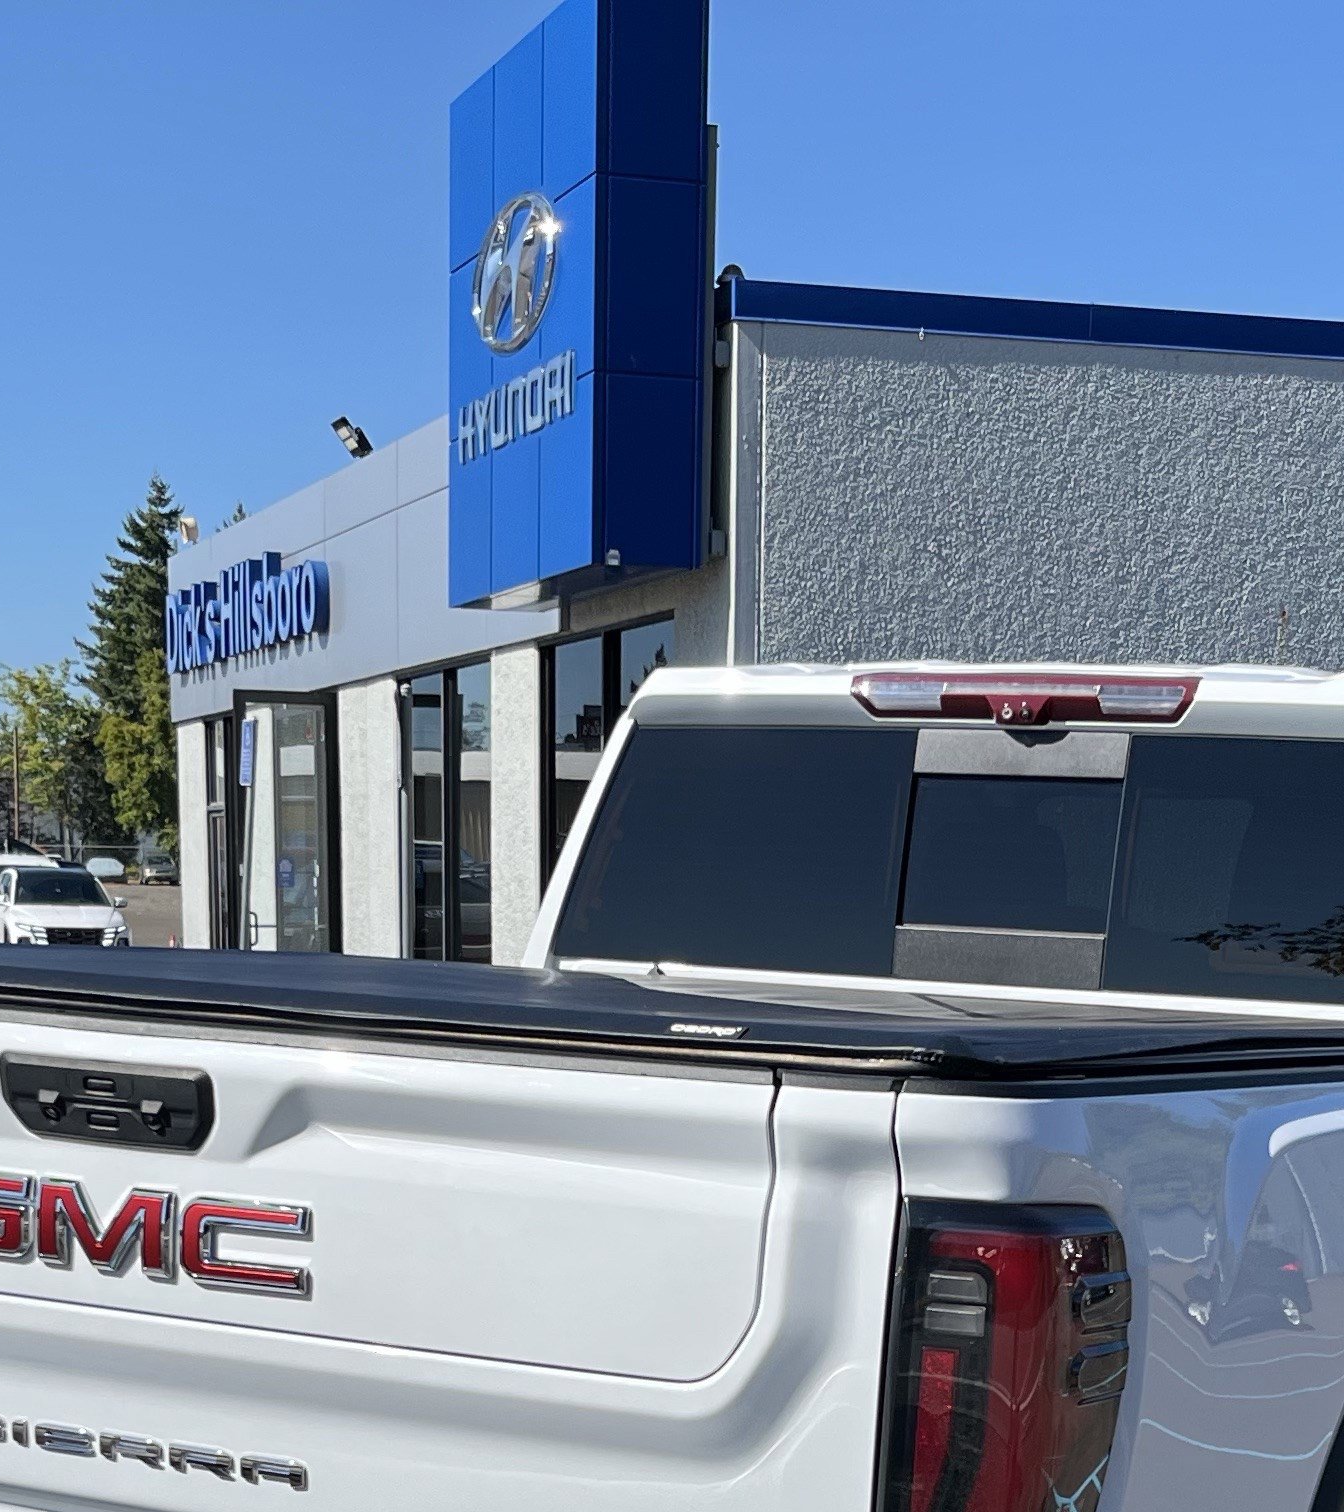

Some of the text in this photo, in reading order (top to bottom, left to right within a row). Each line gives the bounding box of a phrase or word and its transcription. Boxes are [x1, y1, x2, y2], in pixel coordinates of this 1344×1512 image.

[458, 348, 575, 465] HYUNDAI
[166, 551, 320, 675] Dick's Hillsboro
